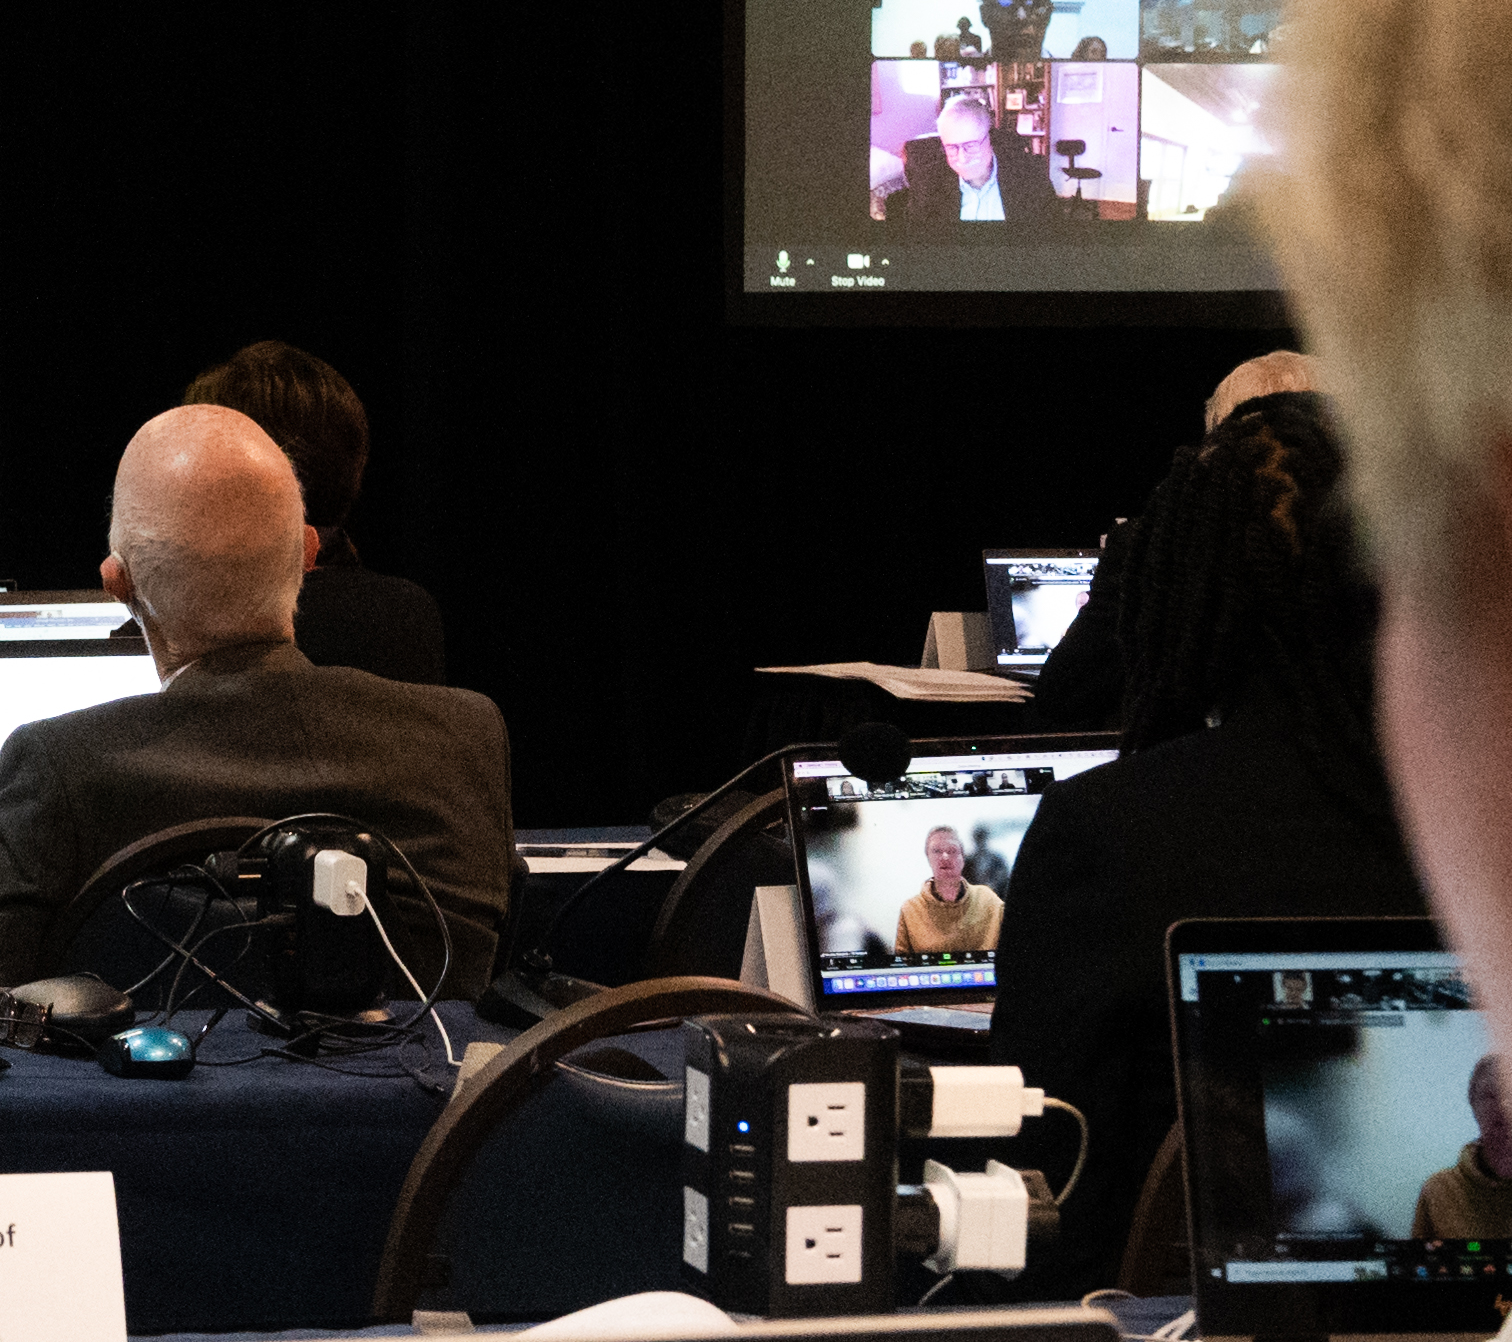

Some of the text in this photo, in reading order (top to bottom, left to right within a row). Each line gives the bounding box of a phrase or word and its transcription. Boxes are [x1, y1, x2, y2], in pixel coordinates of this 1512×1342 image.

[770, 275, 796, 287] Mute
[831, 275, 885, 287] Stop Video
